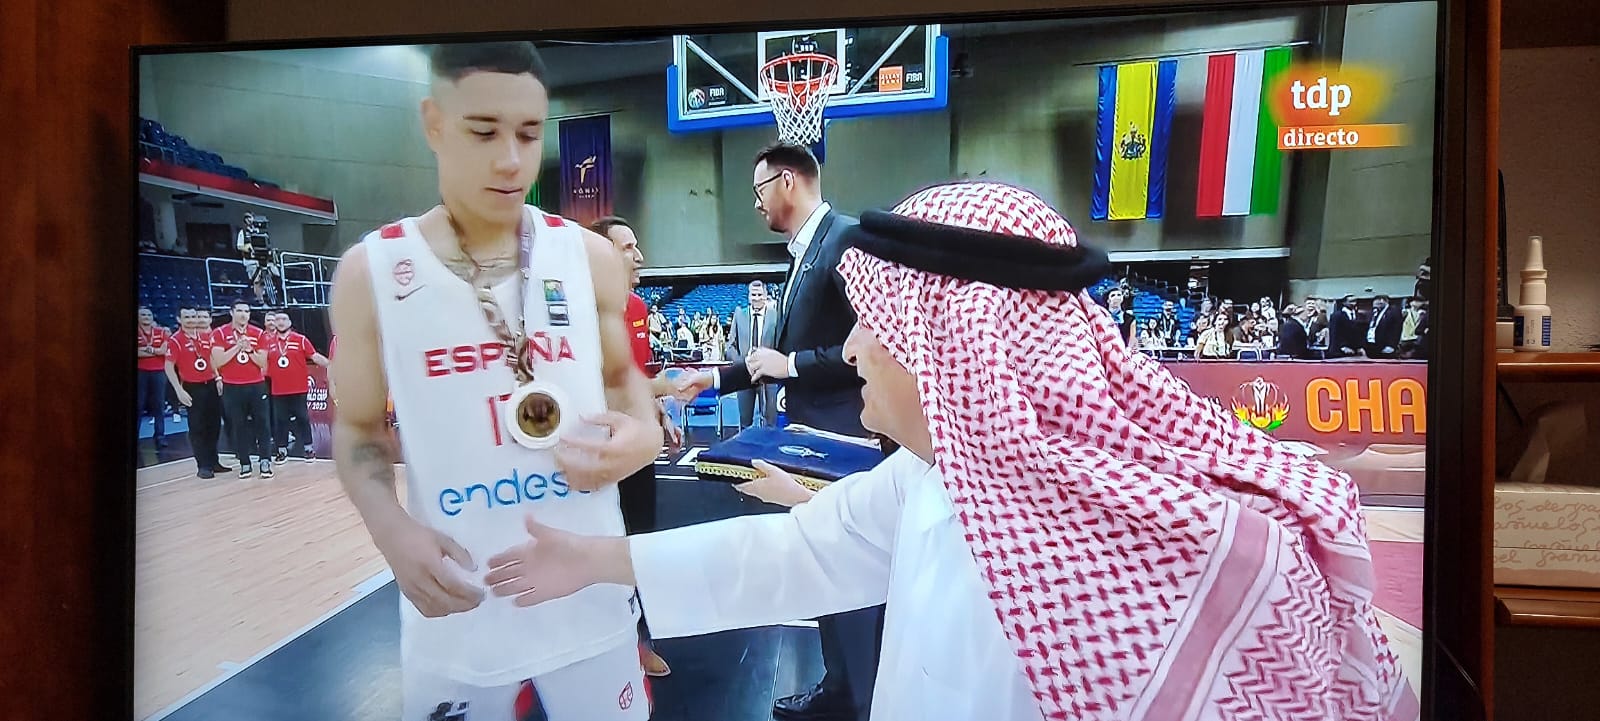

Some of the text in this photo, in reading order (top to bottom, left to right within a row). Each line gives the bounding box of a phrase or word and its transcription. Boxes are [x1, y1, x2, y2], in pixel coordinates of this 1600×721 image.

[1291, 77, 1352, 116] tdp
[1283, 128, 1359, 147] directo
[424, 331, 576, 377] ESPÑA
[1305, 377, 1427, 434] CHA
[439, 468, 592, 516] endes
